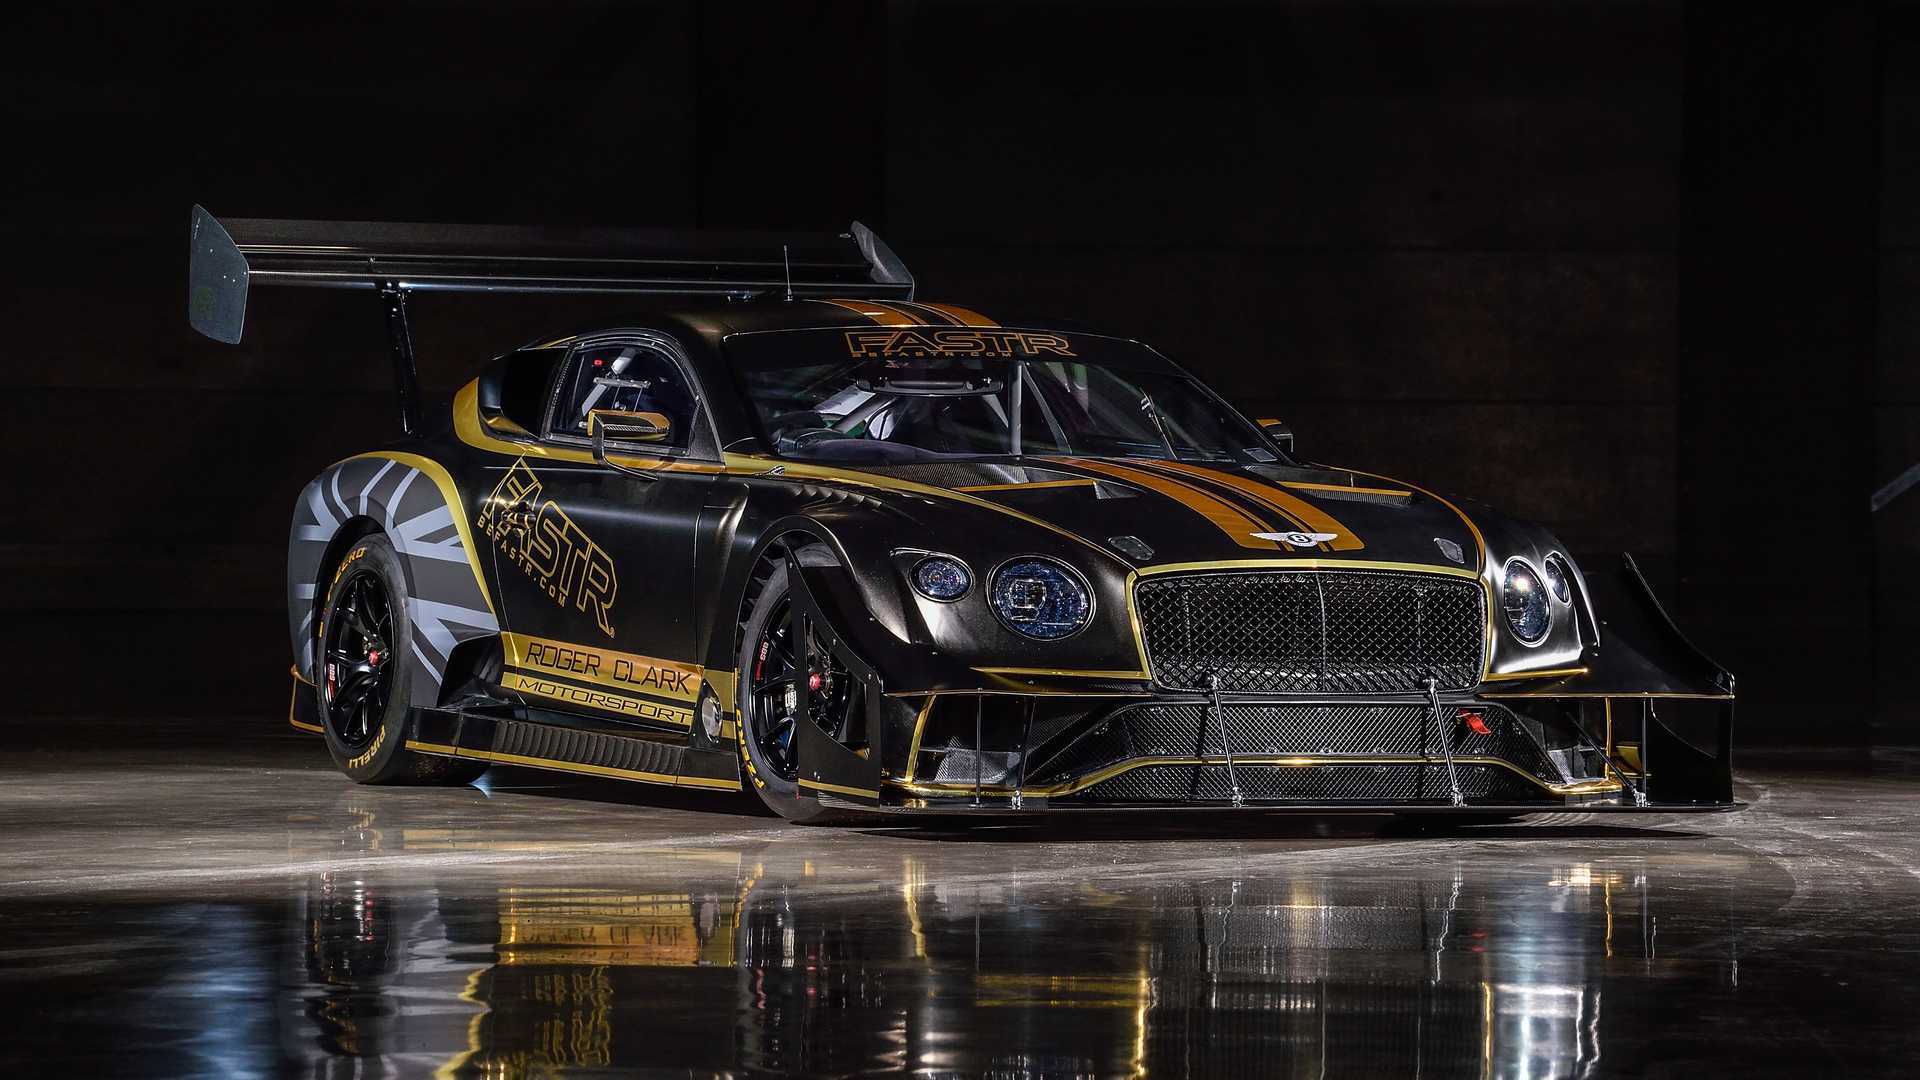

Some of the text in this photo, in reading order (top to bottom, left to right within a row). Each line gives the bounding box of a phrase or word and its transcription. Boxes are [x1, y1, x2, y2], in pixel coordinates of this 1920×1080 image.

[845, 331, 1078, 356] FASTR
[477, 515, 568, 607] BEFASTR.COM
[483, 456, 619, 638] FASTR
[525, 642, 692, 696] ROGER CLARK
[518, 678, 693, 724] MOTORSPORT
[347, 723, 386, 769] PIRELLI
